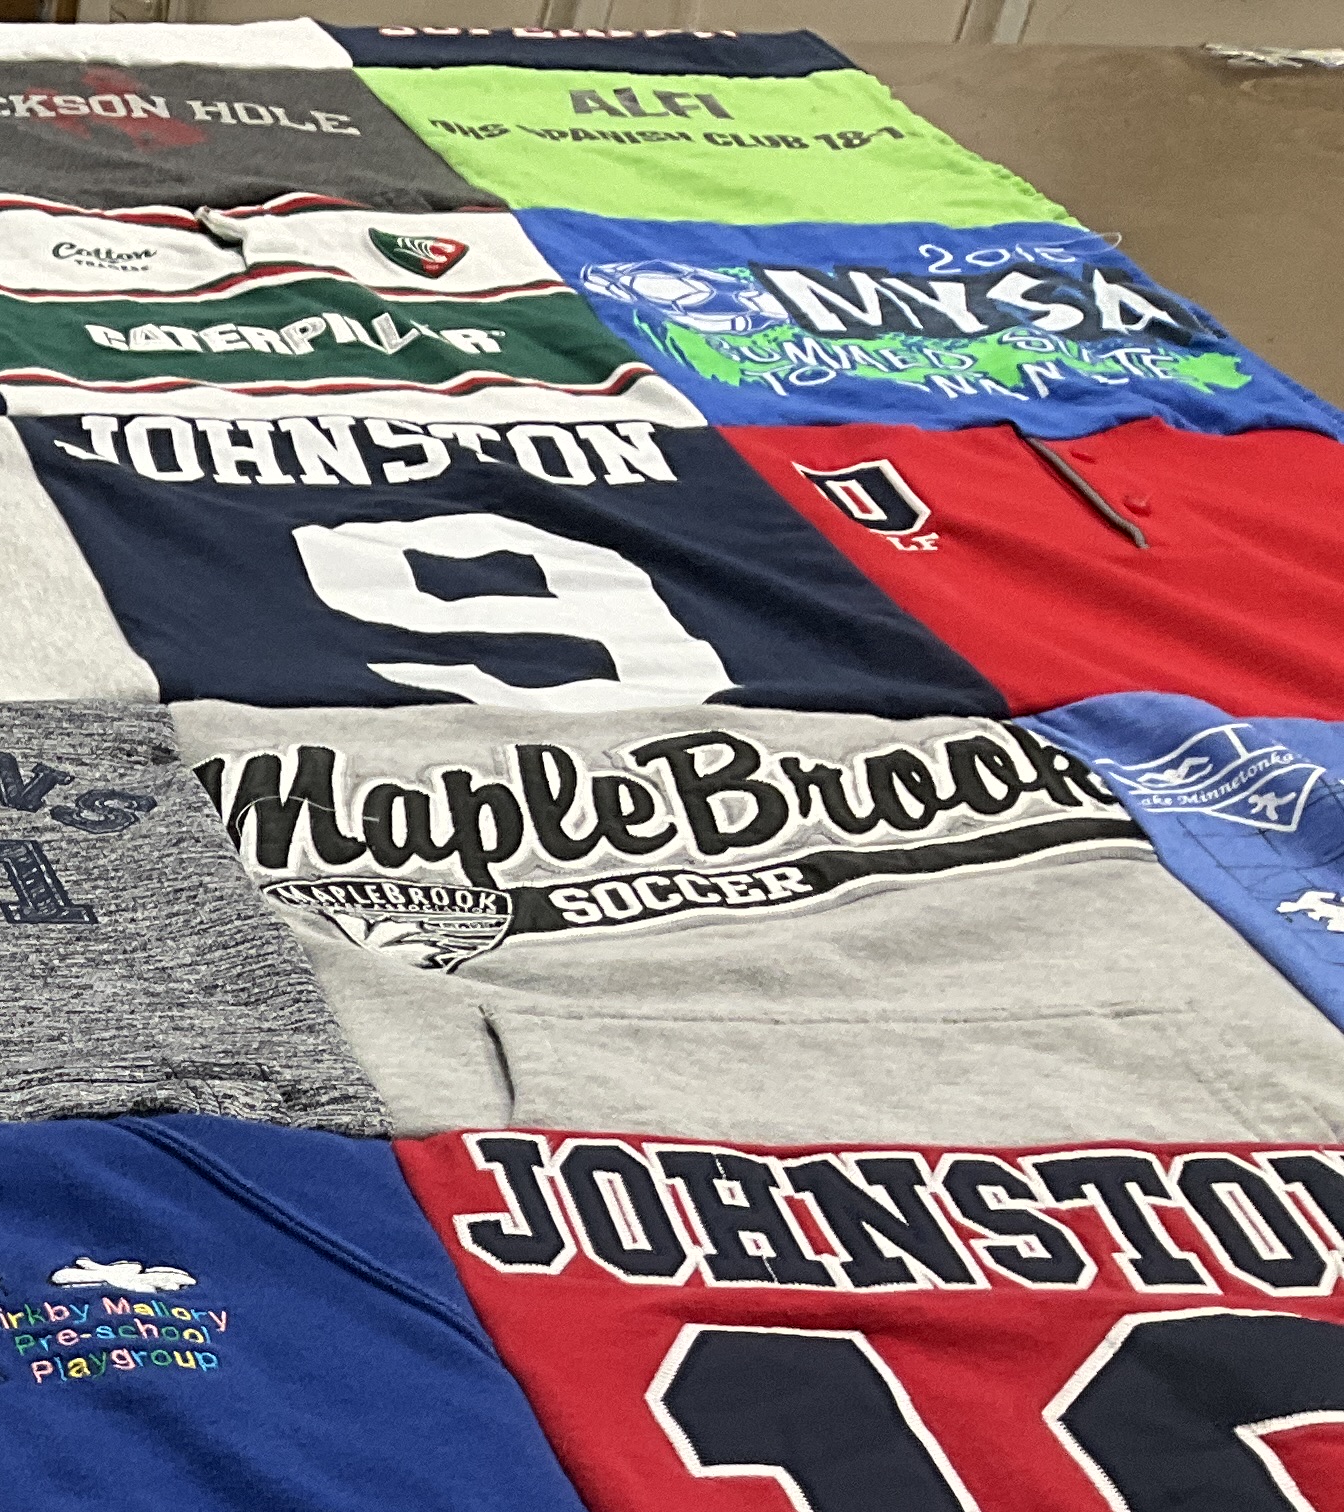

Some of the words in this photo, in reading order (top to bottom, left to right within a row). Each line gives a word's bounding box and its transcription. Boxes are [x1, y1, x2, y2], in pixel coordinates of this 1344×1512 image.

[186, 99, 362, 137] HOLE
[568, 86, 736, 120] ALFI
[515, 123, 692, 146] PANISH
[703, 131, 810, 150] CLUB
[52, 242, 158, 261] Cotton
[762, 266, 1182, 334] MYSA
[53, 415, 679, 487] JOHNSTON
[292, 513, 746, 707] 9
[1141, 793, 1174, 807] ake
[1178, 748, 1295, 806] Minnetonka
[192, 721, 1120, 886] MapleBrook
[275, 881, 498, 911] MAPLEBROOK
[548, 863, 813, 929] SOCCER
[101, 1295, 229, 1334] Mallory
